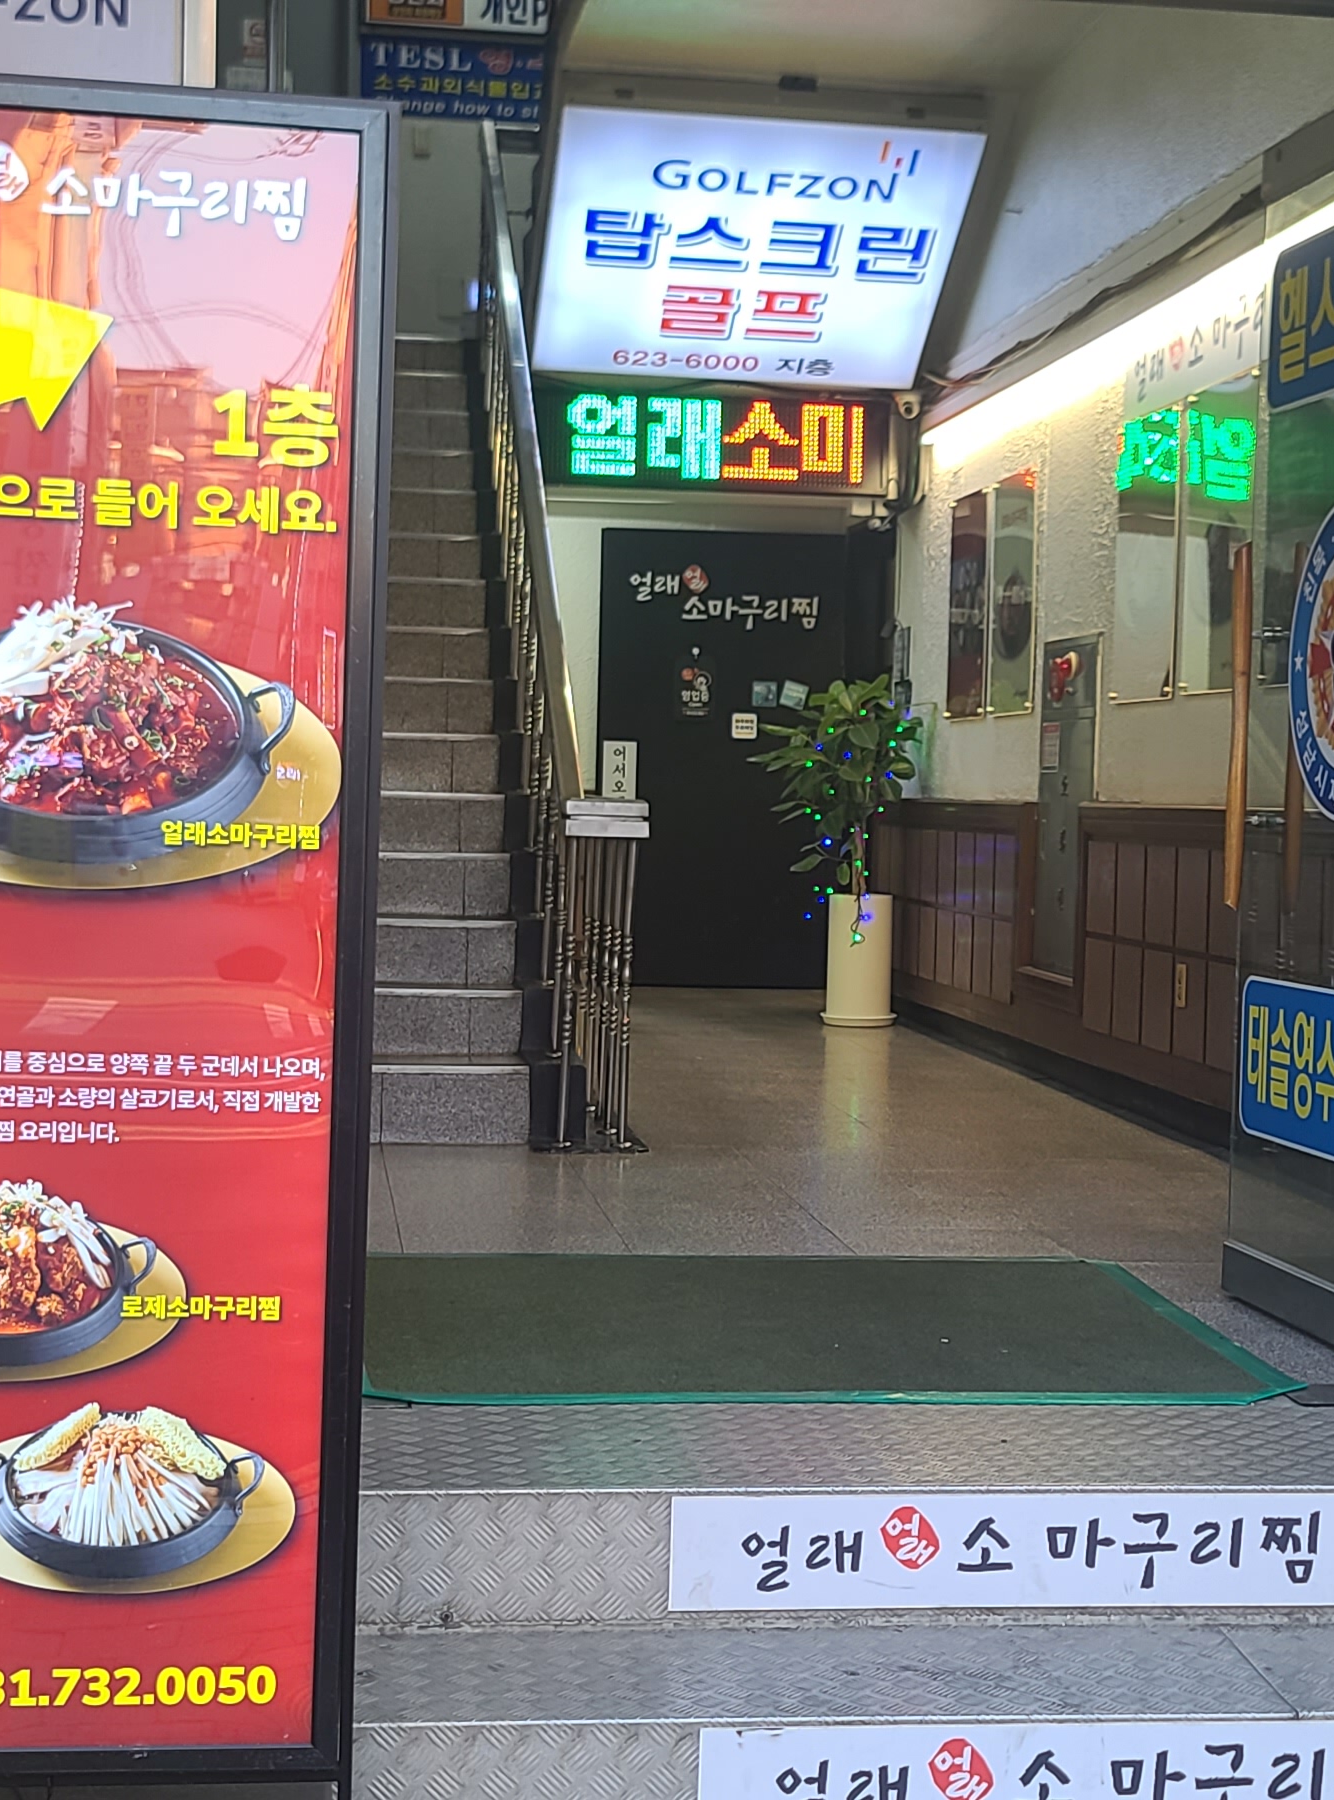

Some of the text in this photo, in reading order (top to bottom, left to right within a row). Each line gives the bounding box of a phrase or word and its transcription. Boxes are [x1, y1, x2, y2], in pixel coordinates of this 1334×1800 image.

[371, 42, 472, 72] TESL
[453, 101, 490, 116] how
[497, 103, 515, 116] to
[652, 156, 899, 203] GOLFZON
[583, 207, 940, 284] 탑스크린
[659, 283, 831, 343] 골프
[612, 350, 834, 378] 623-6000 지층
[213, 384, 339, 467] 1층
[92, 477, 178, 529] 들어
[193, 485, 338, 534] 오세요.
[629, 571, 680, 601] 얼래
[681, 595, 819, 630] 소마구리찜
[612, 744, 627, 799] 어서오
[162, 820, 321, 849] 얼래소마구리찜
[27, 1052, 105, 1073] 중심으로
[110, 1054, 149, 1075] 양쪽
[153, 1055, 173, 1076] 끝
[177, 1056, 198, 1076] 두
[201, 1056, 258, 1078] 군데서
[263, 1057, 326, 1081] 나오며,
[57, 1087, 115, 1109] 소량의
[120, 1088, 219, 1113] 살코기로서,
[222, 1090, 260, 1112] 직접
[263, 1091, 322, 1113] 개발한
[18, 1121, 120, 1144] 요리입니다.
[121, 1294, 281, 1321] 로제소마구리찜
[740, 1523, 864, 1592] 얼래
